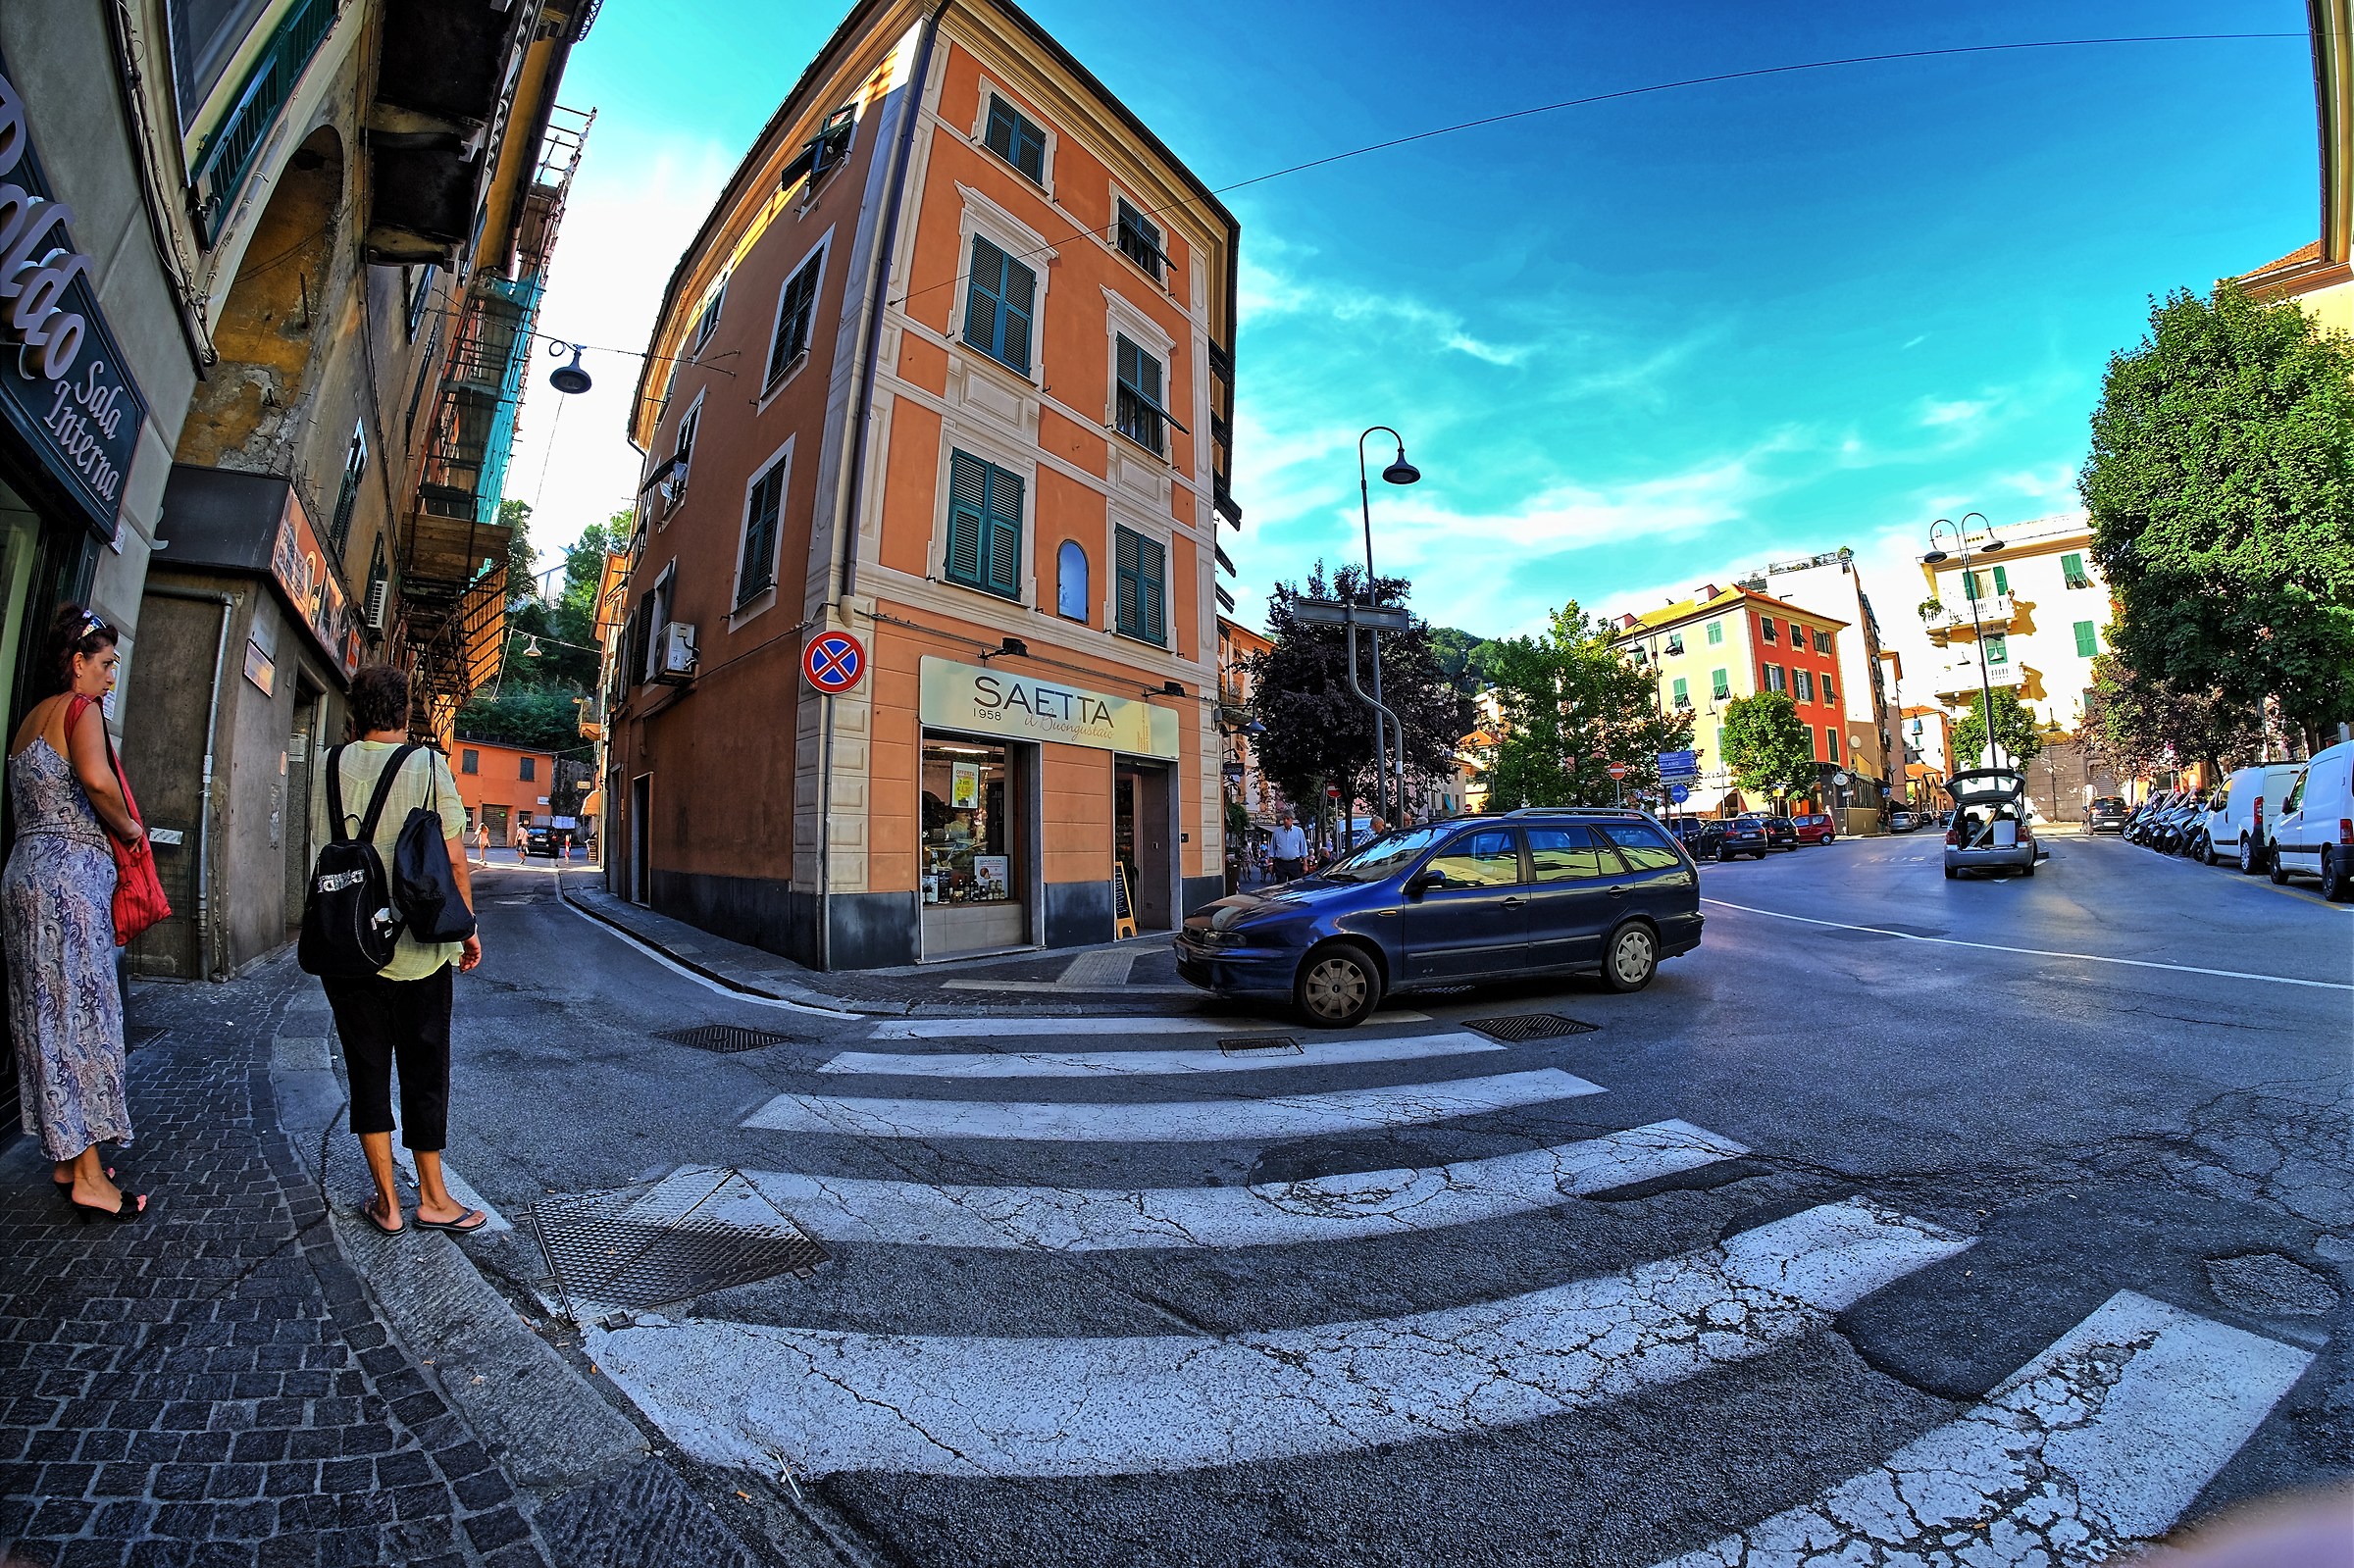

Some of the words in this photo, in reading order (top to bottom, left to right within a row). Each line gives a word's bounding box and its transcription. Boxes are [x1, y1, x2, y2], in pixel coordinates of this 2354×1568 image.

[75, 360, 123, 440] Sala
[43, 379, 121, 502] Interna
[973, 676, 1114, 729] SAETTA
[973, 707, 1001, 721] 1958
[1024, 708, 1038, 727] il
[1040, 707, 1115, 741] Buongustaio
